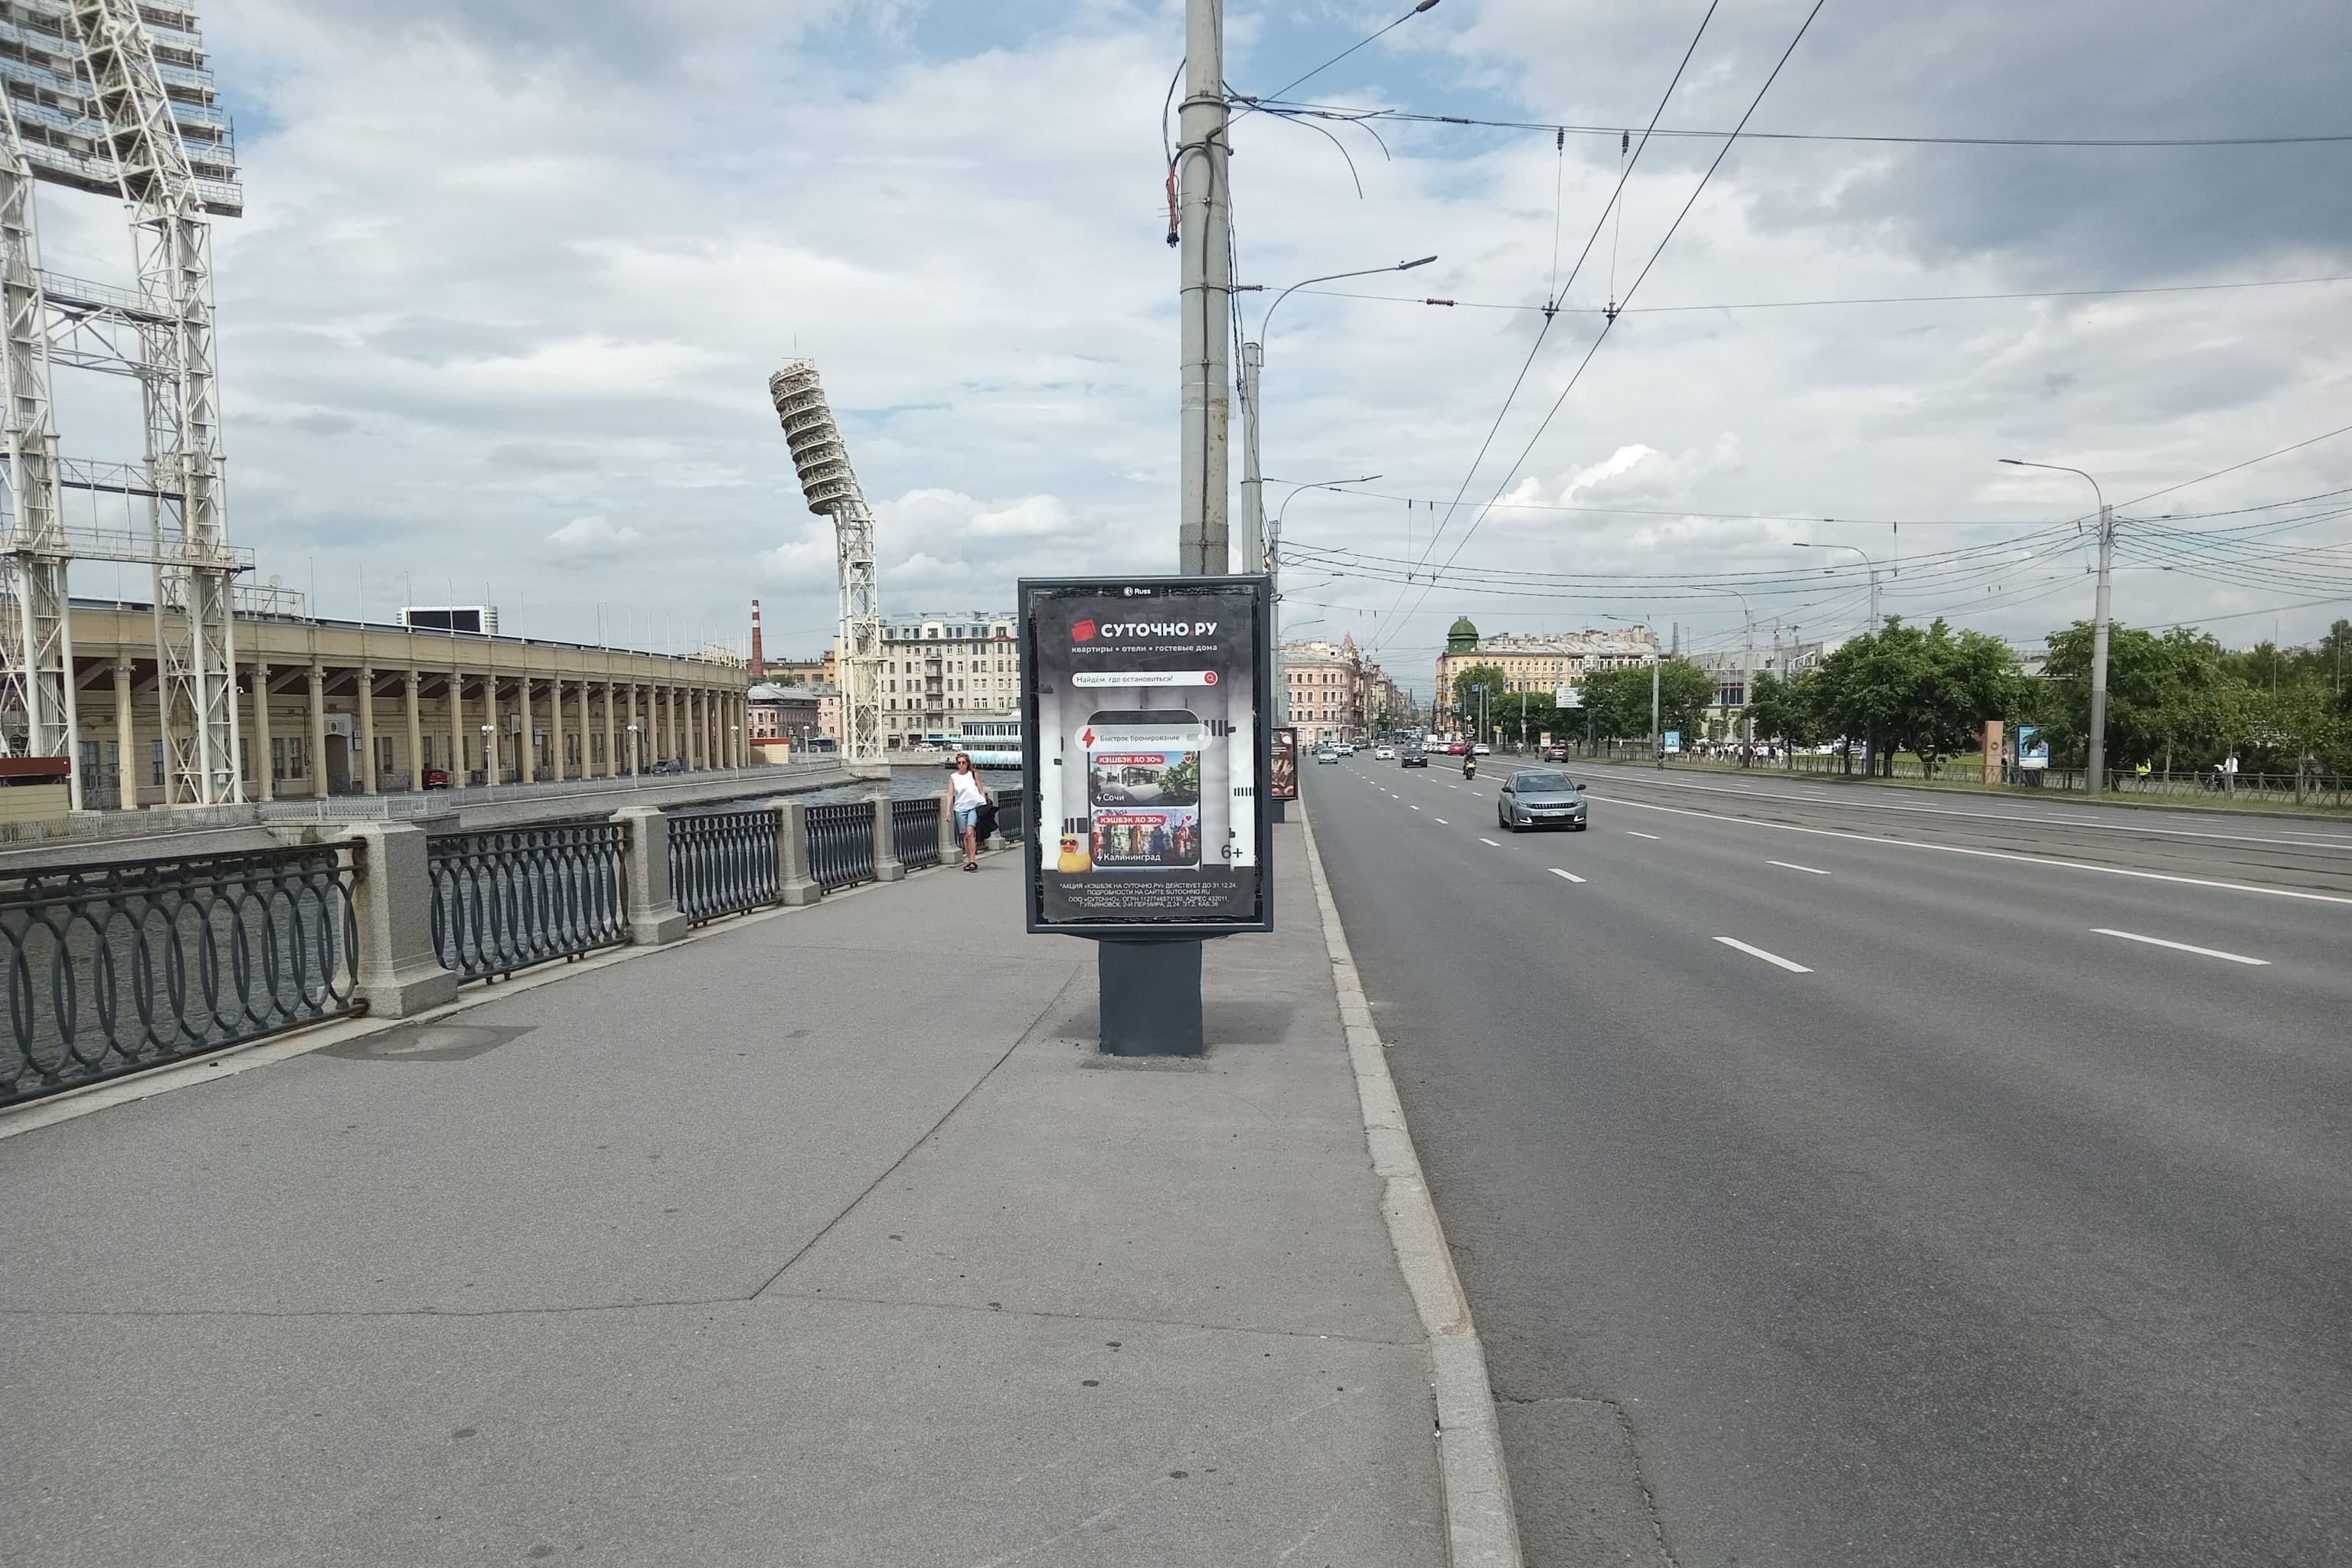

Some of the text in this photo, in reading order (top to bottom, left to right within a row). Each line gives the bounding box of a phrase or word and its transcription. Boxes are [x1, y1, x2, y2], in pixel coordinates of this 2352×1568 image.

[1100, 622, 1217, 638] СУТОЧНО.РУ
[1071, 645, 1113, 654] квартиры
[1099, 756, 1132, 764] КЭШБЭК
[1102, 793, 1125, 802] Сочи
[1147, 815, 1163, 824] 30%
[1220, 844, 1244, 859] 6+
[1103, 853, 1161, 862] Калининград
